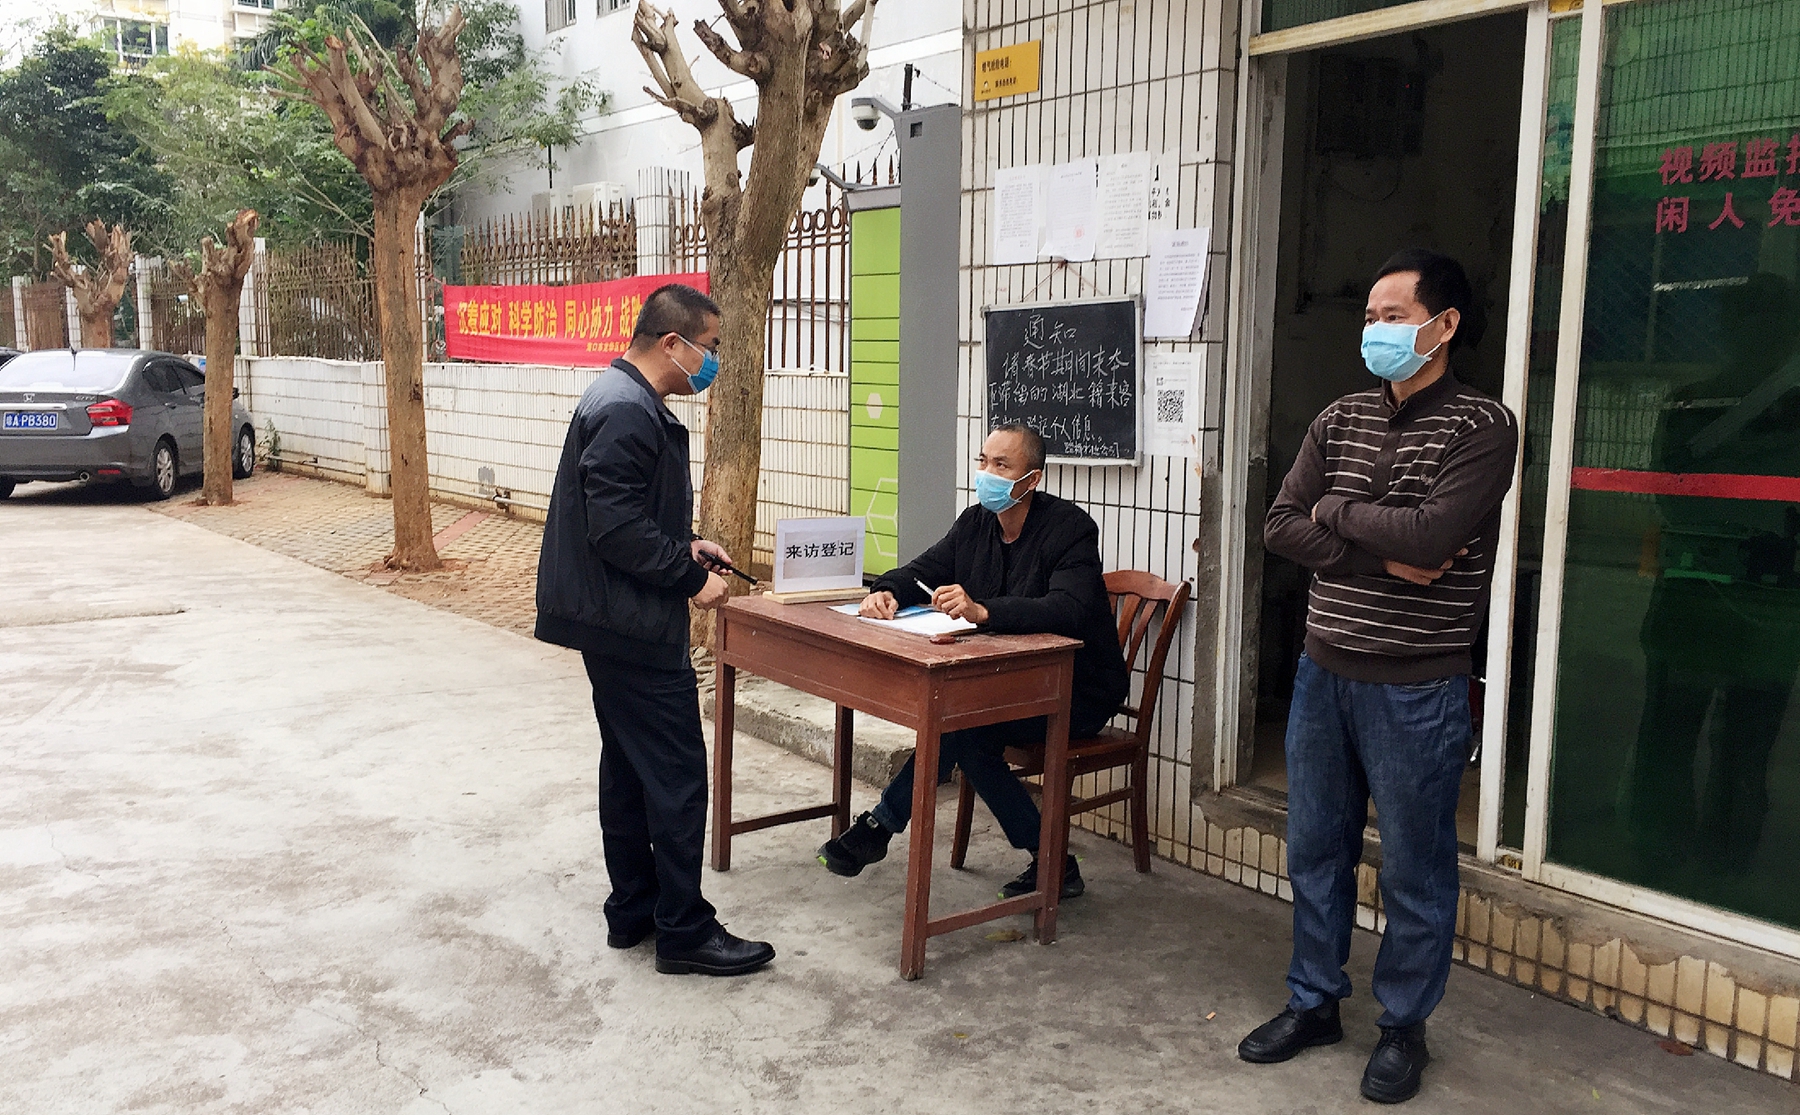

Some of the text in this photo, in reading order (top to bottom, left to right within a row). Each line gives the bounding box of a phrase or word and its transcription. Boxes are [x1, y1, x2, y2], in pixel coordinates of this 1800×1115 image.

[457, 299, 502, 337] 沉着应对
[508, 300, 558, 338] 科学防治
[564, 298, 614, 339] 同心协力
[1023, 311, 1077, 349] 通知
[785, 542, 854, 559] 来访登记
